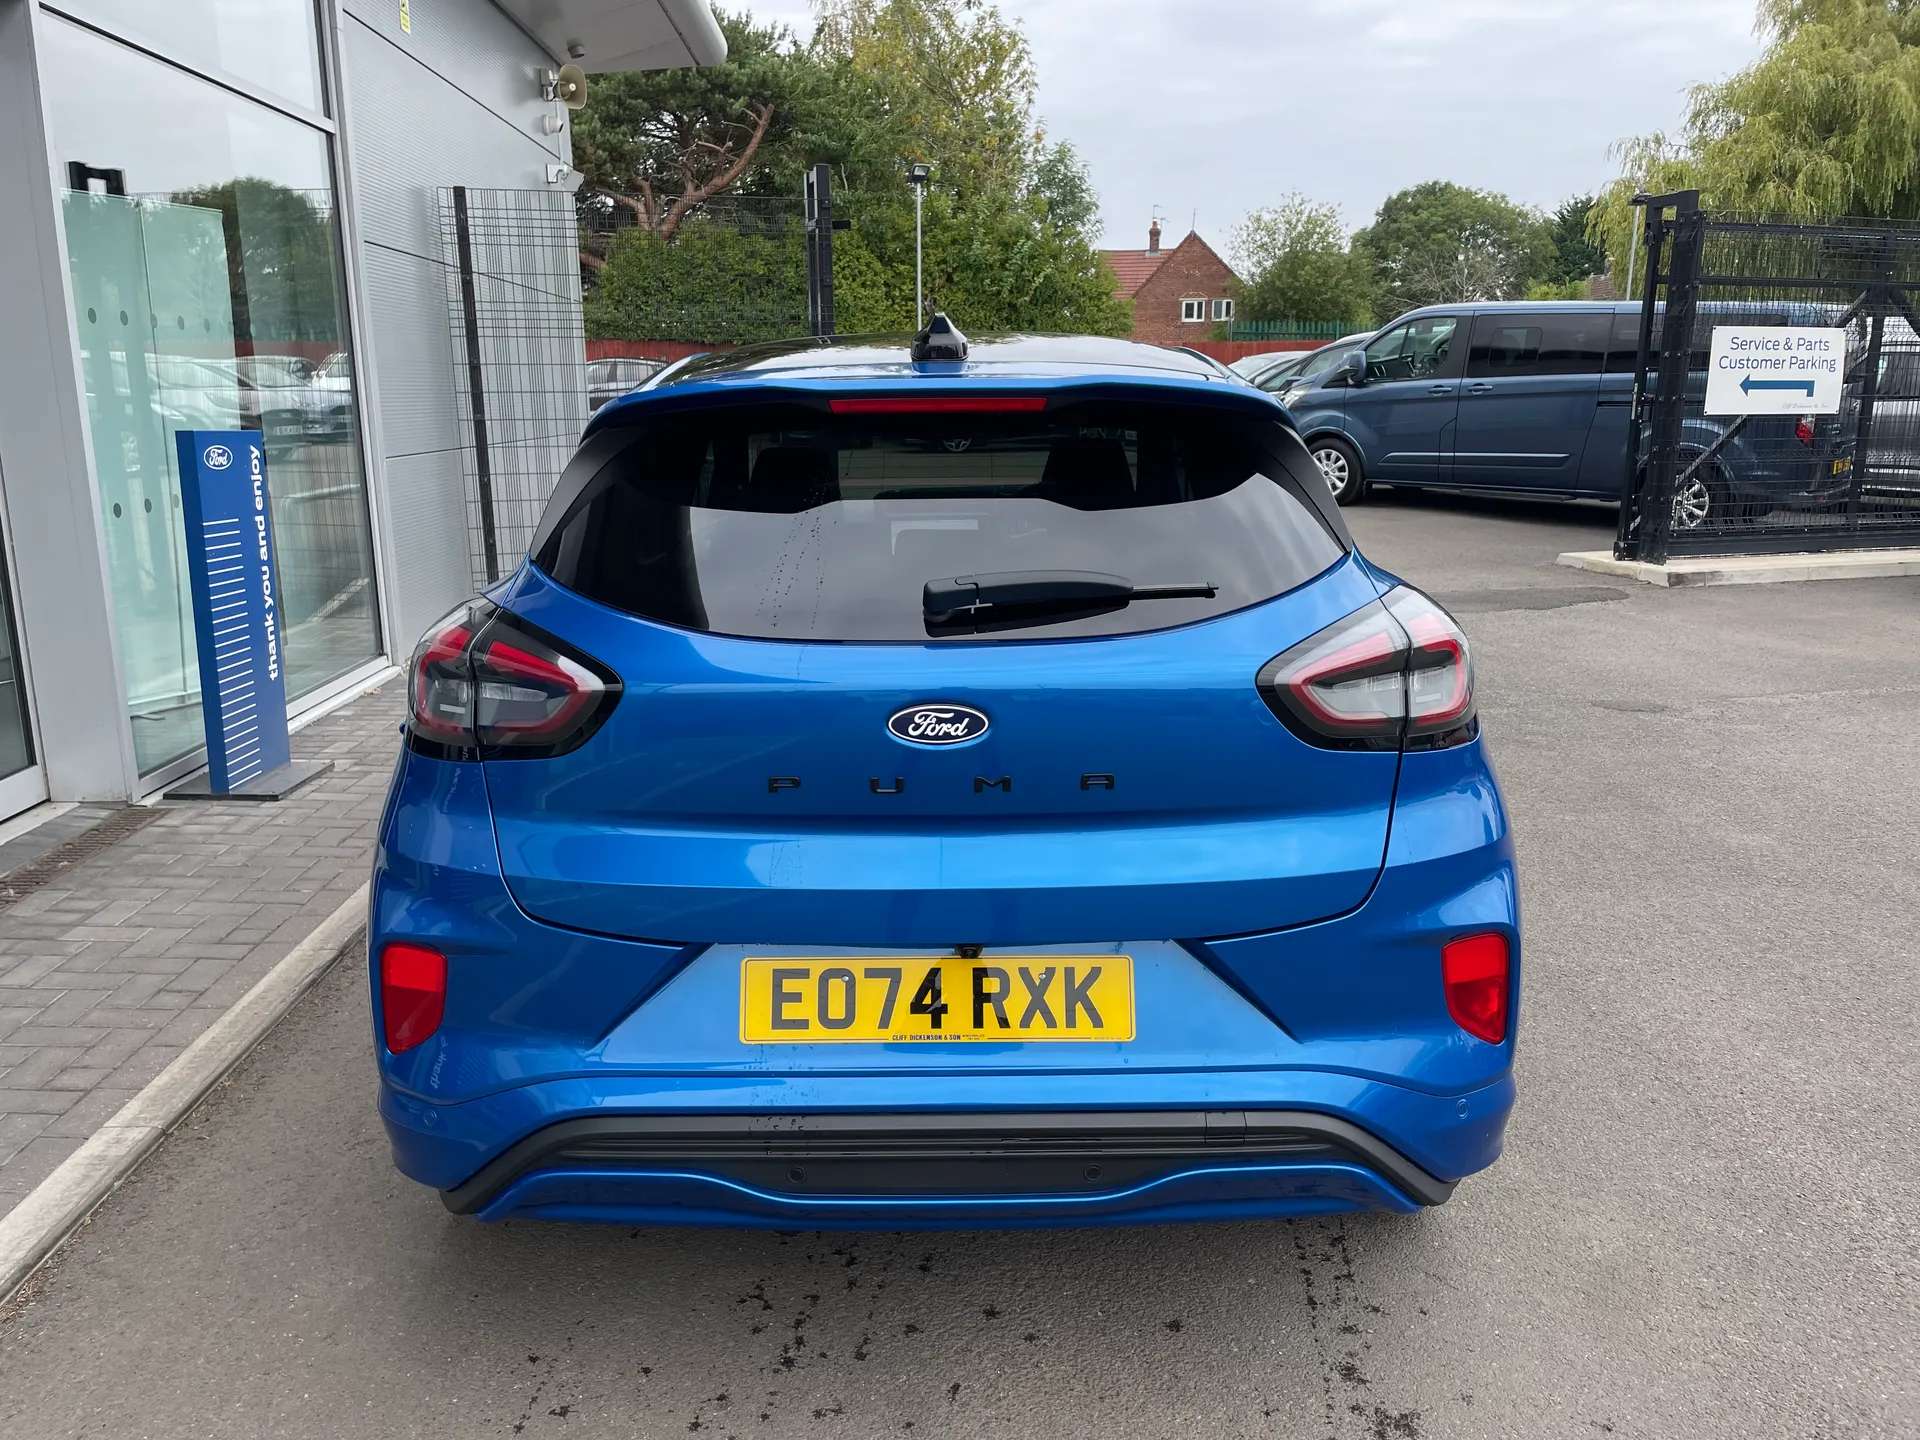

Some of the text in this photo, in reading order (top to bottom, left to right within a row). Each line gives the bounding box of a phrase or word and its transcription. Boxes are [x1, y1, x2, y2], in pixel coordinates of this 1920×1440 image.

[1730, 336, 1830, 351] Service & Parts
[1719, 355, 1836, 372] Customer Parking
[209, 448, 228, 466] Ford
[249, 445, 278, 680] thank you and enjoy
[908, 711, 968, 737] Ford
[768, 773, 1115, 794] PUMA
[771, 966, 1104, 1029] EO74 RXK
